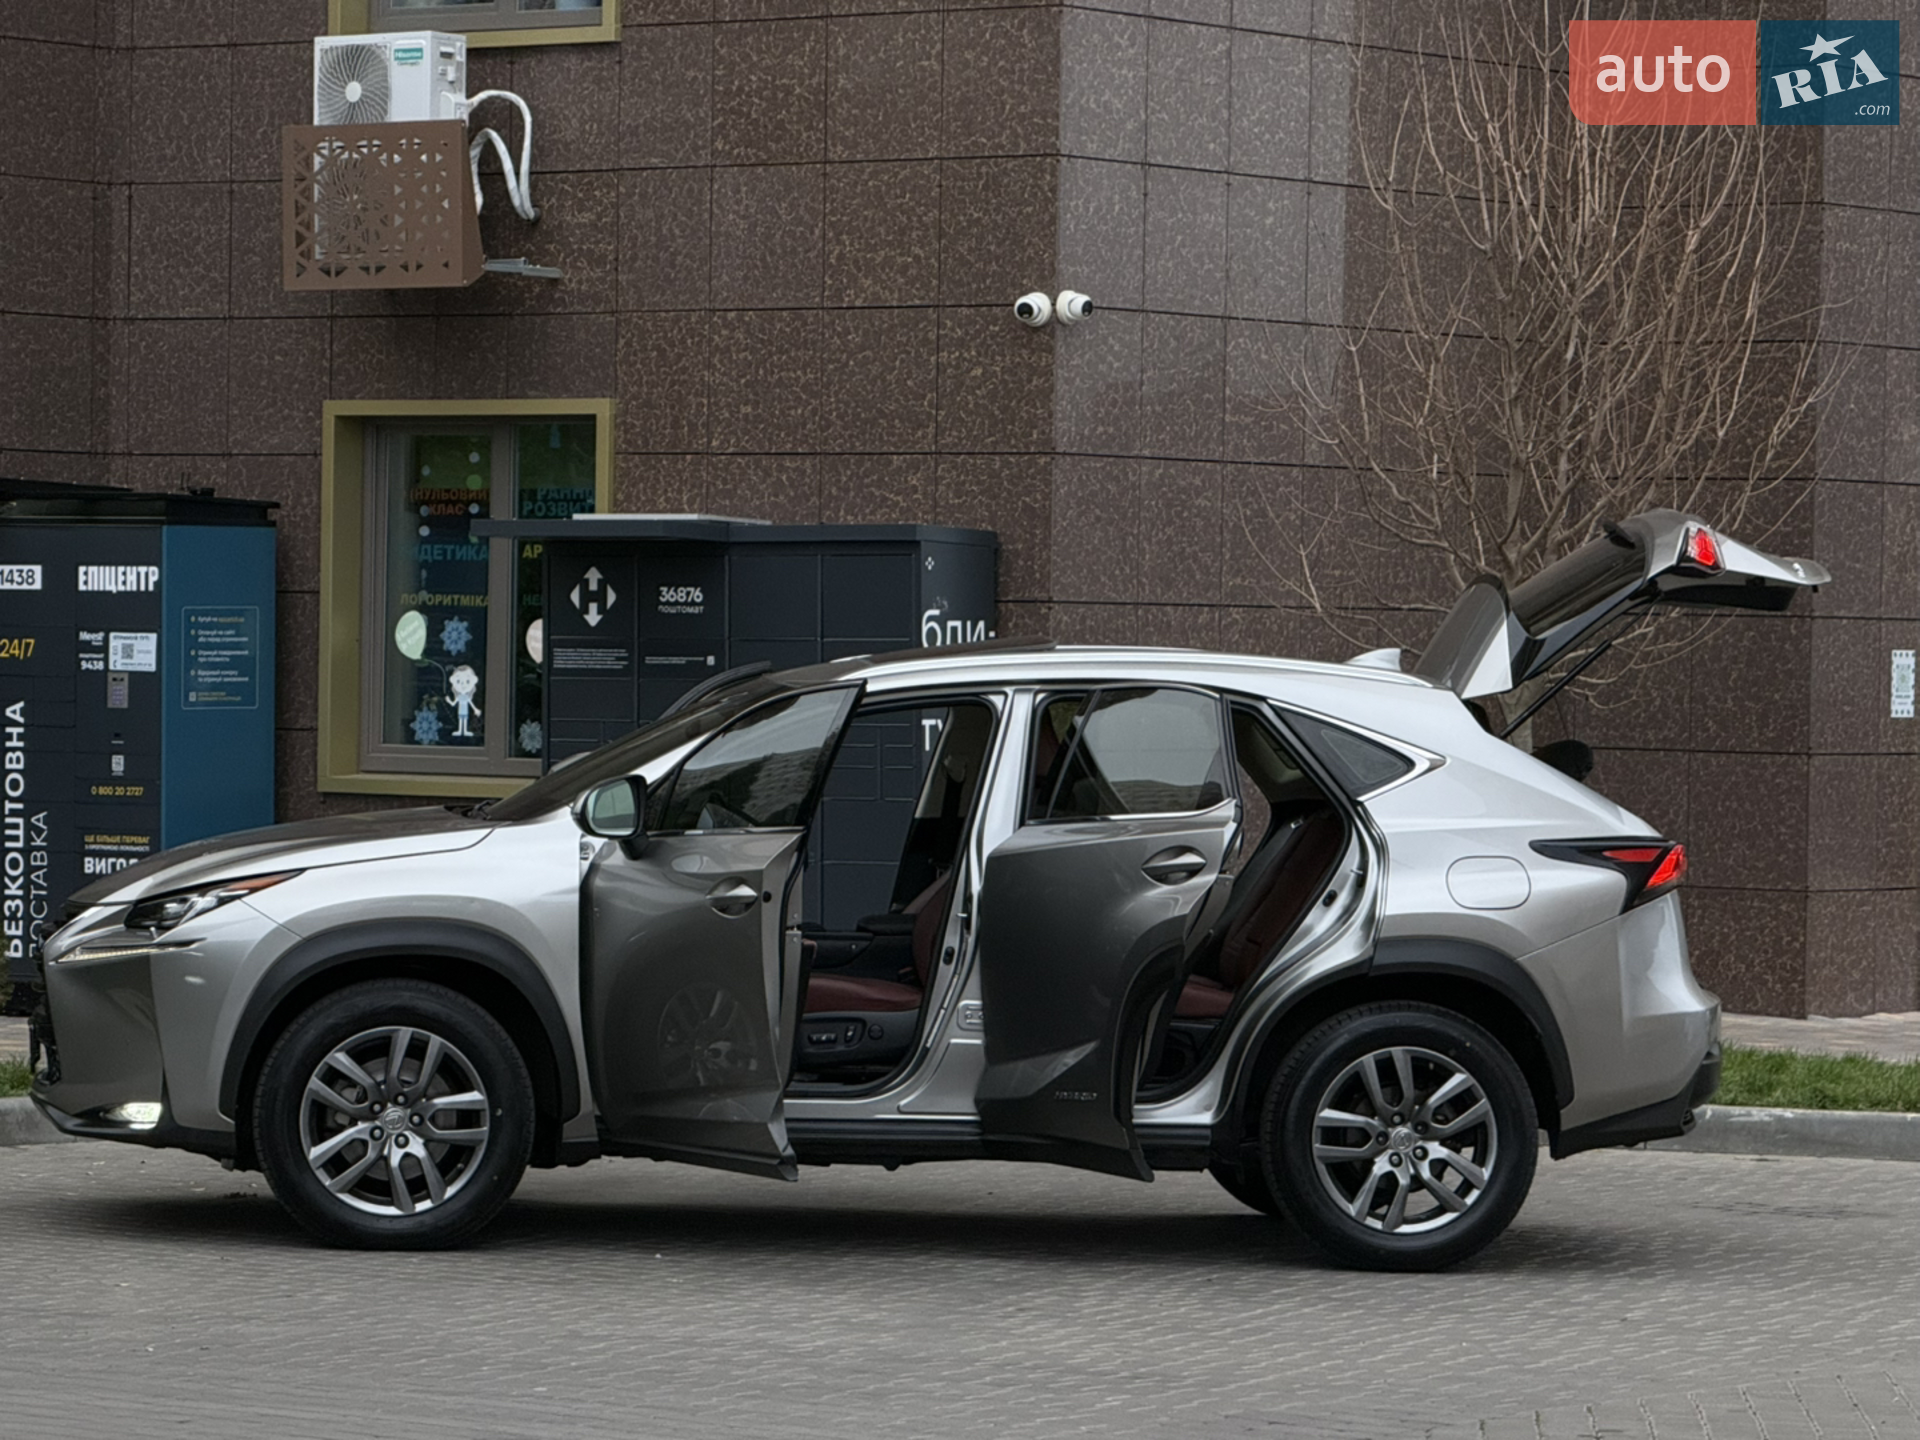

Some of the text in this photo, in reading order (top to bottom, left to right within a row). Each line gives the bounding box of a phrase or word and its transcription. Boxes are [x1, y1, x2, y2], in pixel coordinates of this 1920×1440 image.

[78, 565, 160, 593] ЕПІЦЕНТР
[658, 586, 704, 602] 36876
[657, 604, 705, 613] поштомат
[0, 638, 36, 660] 24/7
[91, 786, 144, 796] 0 800 20 2727
[4, 700, 25, 958] БЕЗКОШТОВНА
